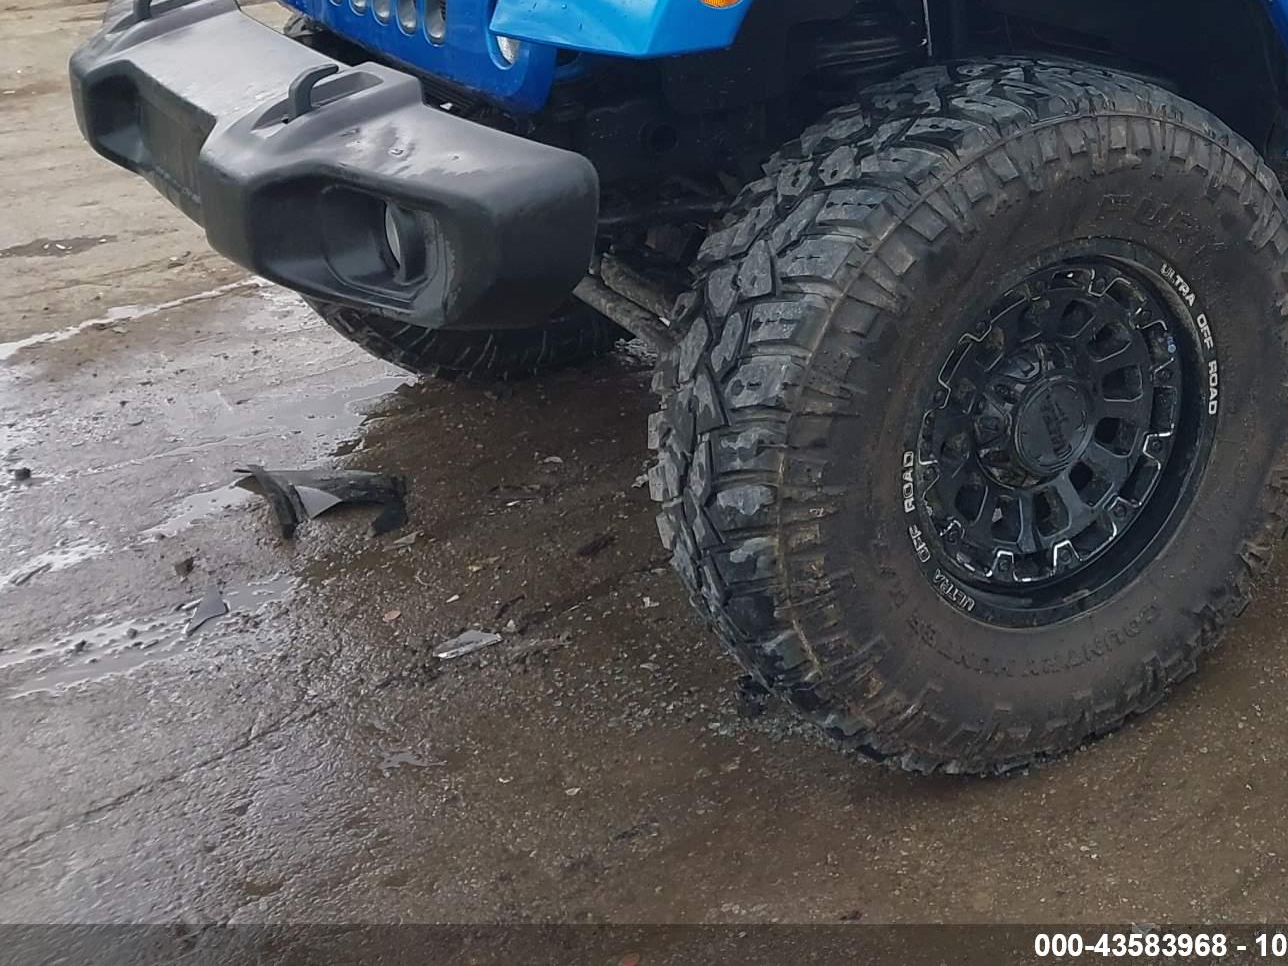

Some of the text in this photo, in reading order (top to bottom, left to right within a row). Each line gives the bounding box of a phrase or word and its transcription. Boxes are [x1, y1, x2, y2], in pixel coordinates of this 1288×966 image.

[1161, 263, 1219, 415] ULTRA OFF ROAD
[902, 451, 915, 513] ROAD
[909, 524, 931, 562] OFF
